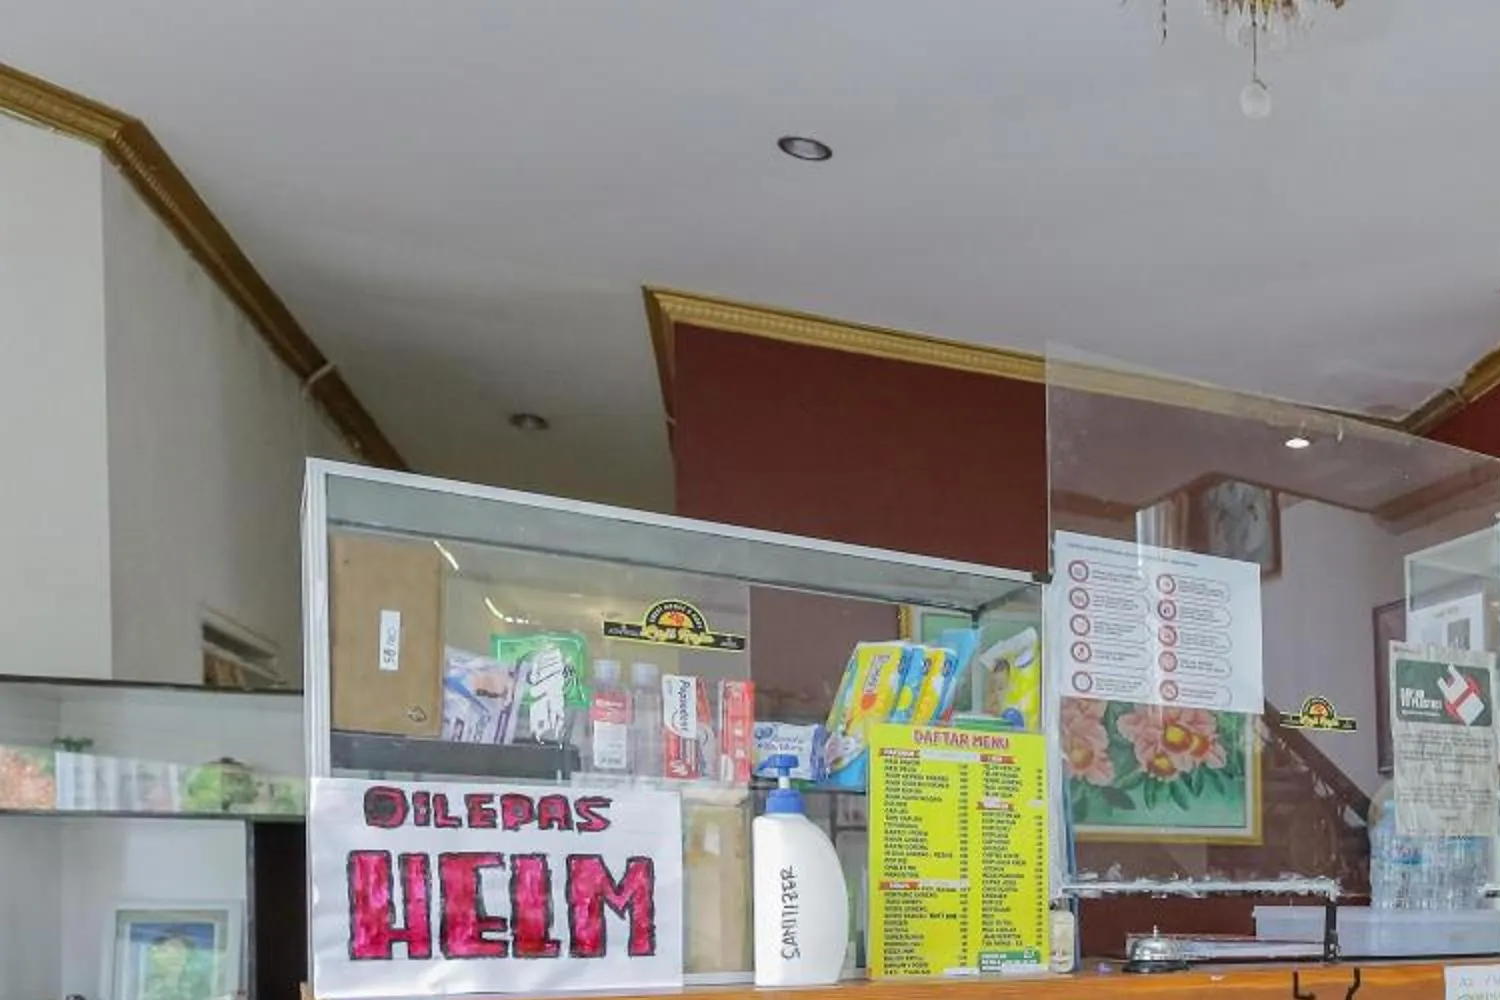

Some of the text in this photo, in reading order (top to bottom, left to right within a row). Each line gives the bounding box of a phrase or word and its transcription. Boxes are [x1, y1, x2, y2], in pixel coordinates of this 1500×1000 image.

[913, 729, 1011, 750] DAFTAR MENU
[363, 785, 613, 833] DILEPAS
[347, 849, 657, 961] HELM
[780, 865, 800, 960] SANITIZER
